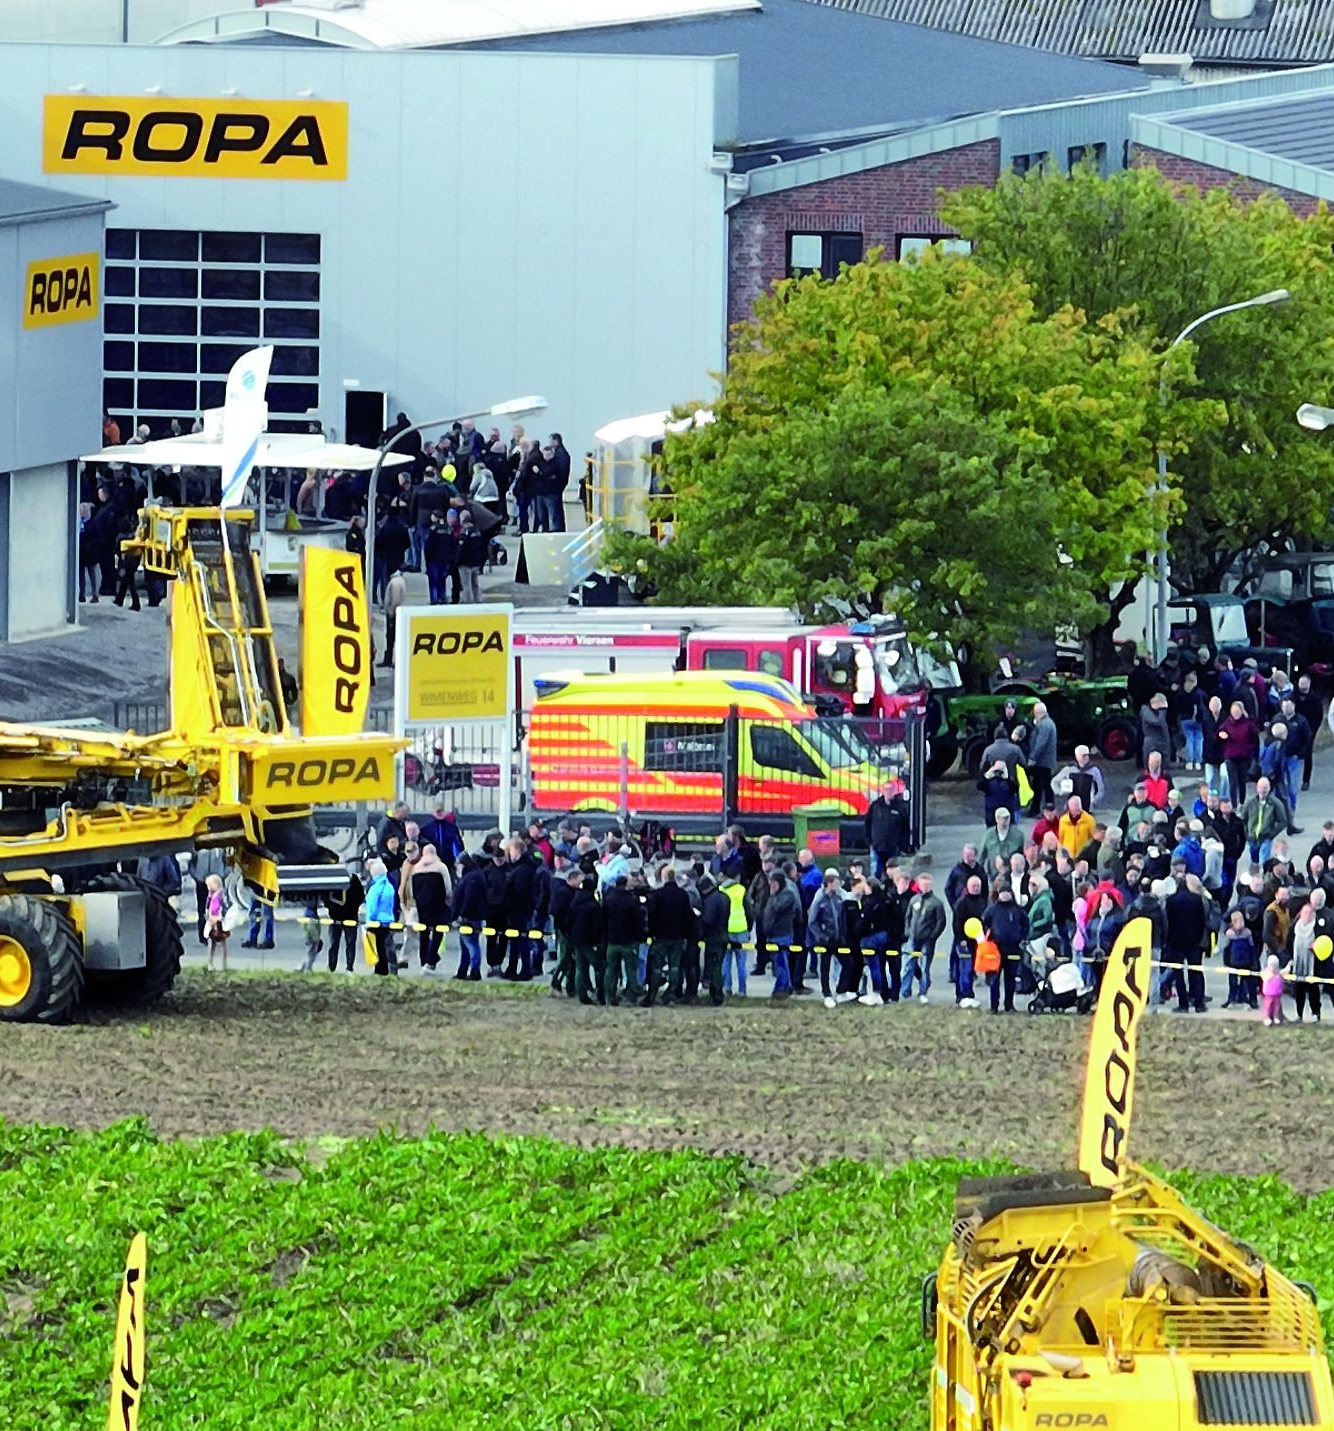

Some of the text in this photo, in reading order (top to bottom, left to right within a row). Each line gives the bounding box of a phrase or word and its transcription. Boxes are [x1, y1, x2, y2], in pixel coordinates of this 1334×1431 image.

[61, 110, 328, 166] ROPA
[29, 266, 92, 315] ROPA
[333, 566, 362, 713] ROPA
[413, 630, 504, 655] ROPA
[267, 757, 380, 787] ROPA
[1101, 946, 1143, 1178] ROPA
[1034, 1414, 1109, 1428] ROPA
